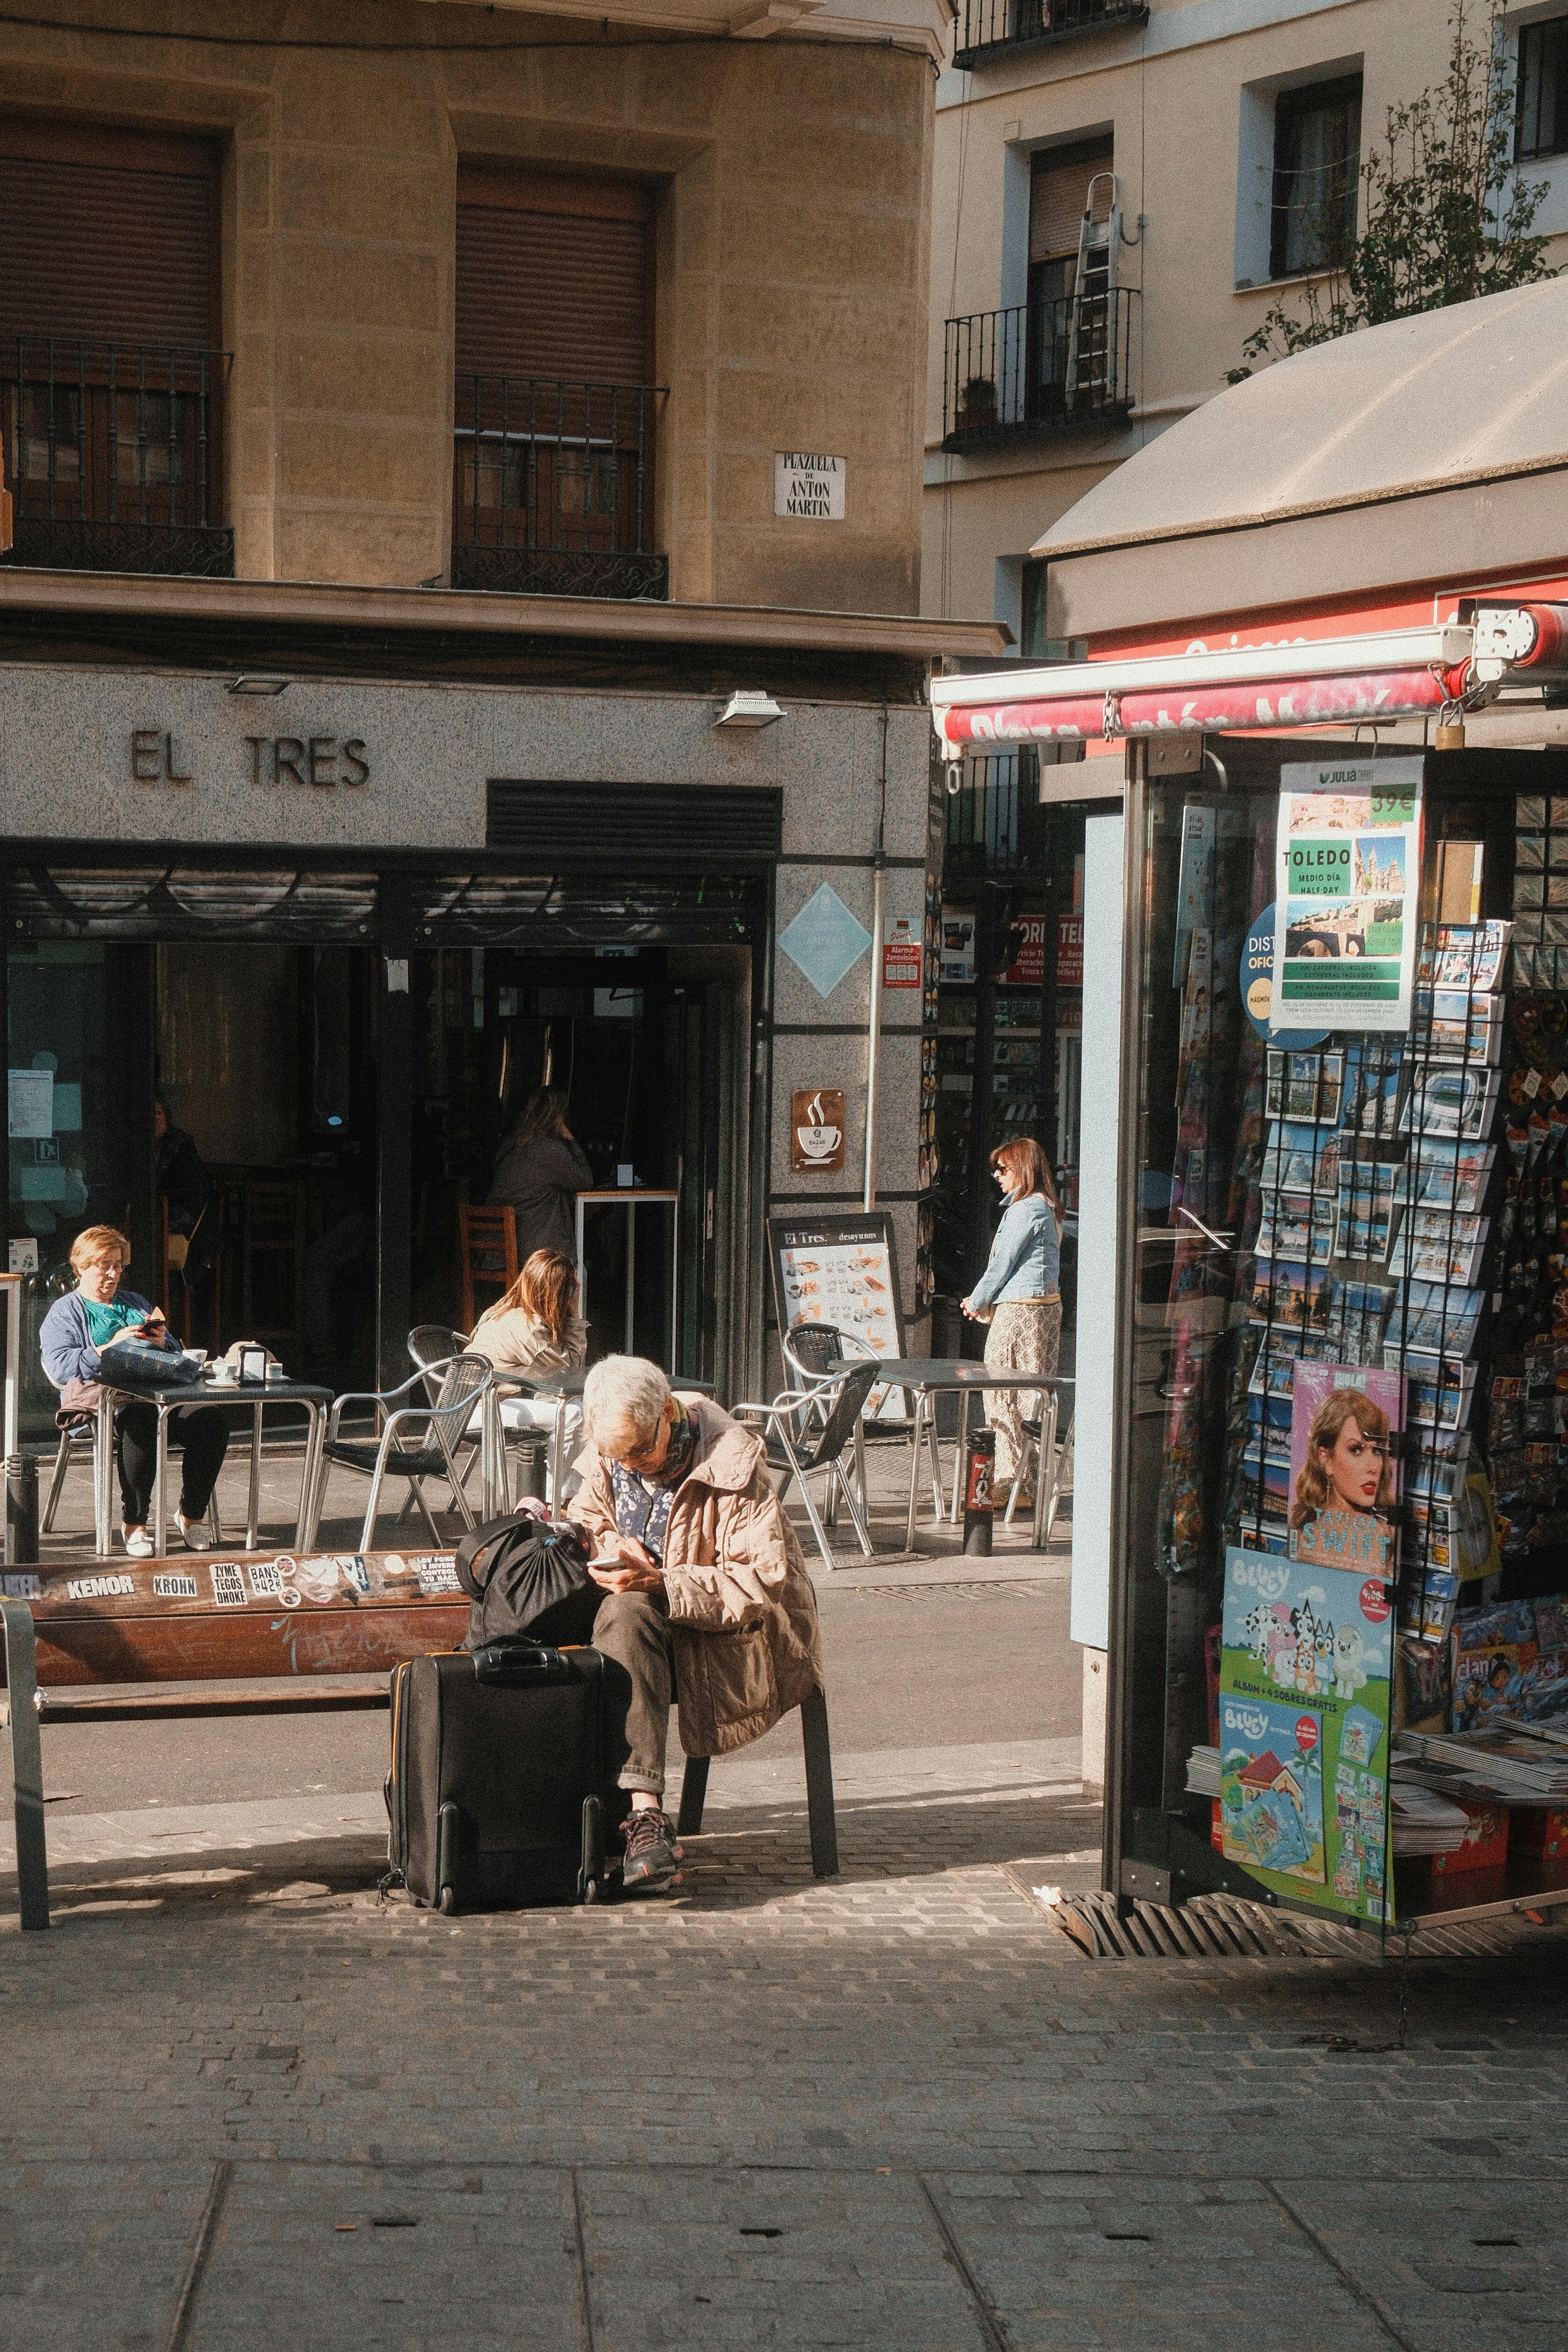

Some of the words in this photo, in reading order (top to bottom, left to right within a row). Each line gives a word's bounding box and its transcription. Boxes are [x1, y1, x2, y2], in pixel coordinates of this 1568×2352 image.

[783, 453, 837, 472] PLAZUELA
[790, 480, 830, 498] ANTON
[787, 498, 830, 516] MARTIN
[132, 730, 193, 780] EL
[245, 737, 370, 786] TRES
[1372, 791, 1413, 813] 39€
[1283, 849, 1350, 866] TOLEDO
[1248, 956, 1274, 969] OFIC
[784, 1233, 796, 1244] El
[839, 1232, 876, 1242] desayunos
[1315, 1508, 1378, 1531] TAYLOR
[1302, 1523, 1391, 1563] SWIFT
[215, 1565, 238, 1577] ZYME
[250, 1566, 279, 1580] BANS
[67, 1575, 135, 1600] KEMOR
[154, 1577, 196, 1595] KROHN
[214, 1578, 242, 1590] TEGOS
[217, 1591, 246, 1604] DHOKE
[1233, 1680, 1260, 1694] ALBUM
[1267, 1687, 1273, 1697] 4
[1274, 1690, 1306, 1706] SOBRES
[1307, 1698, 1338, 1713] GRATIS
